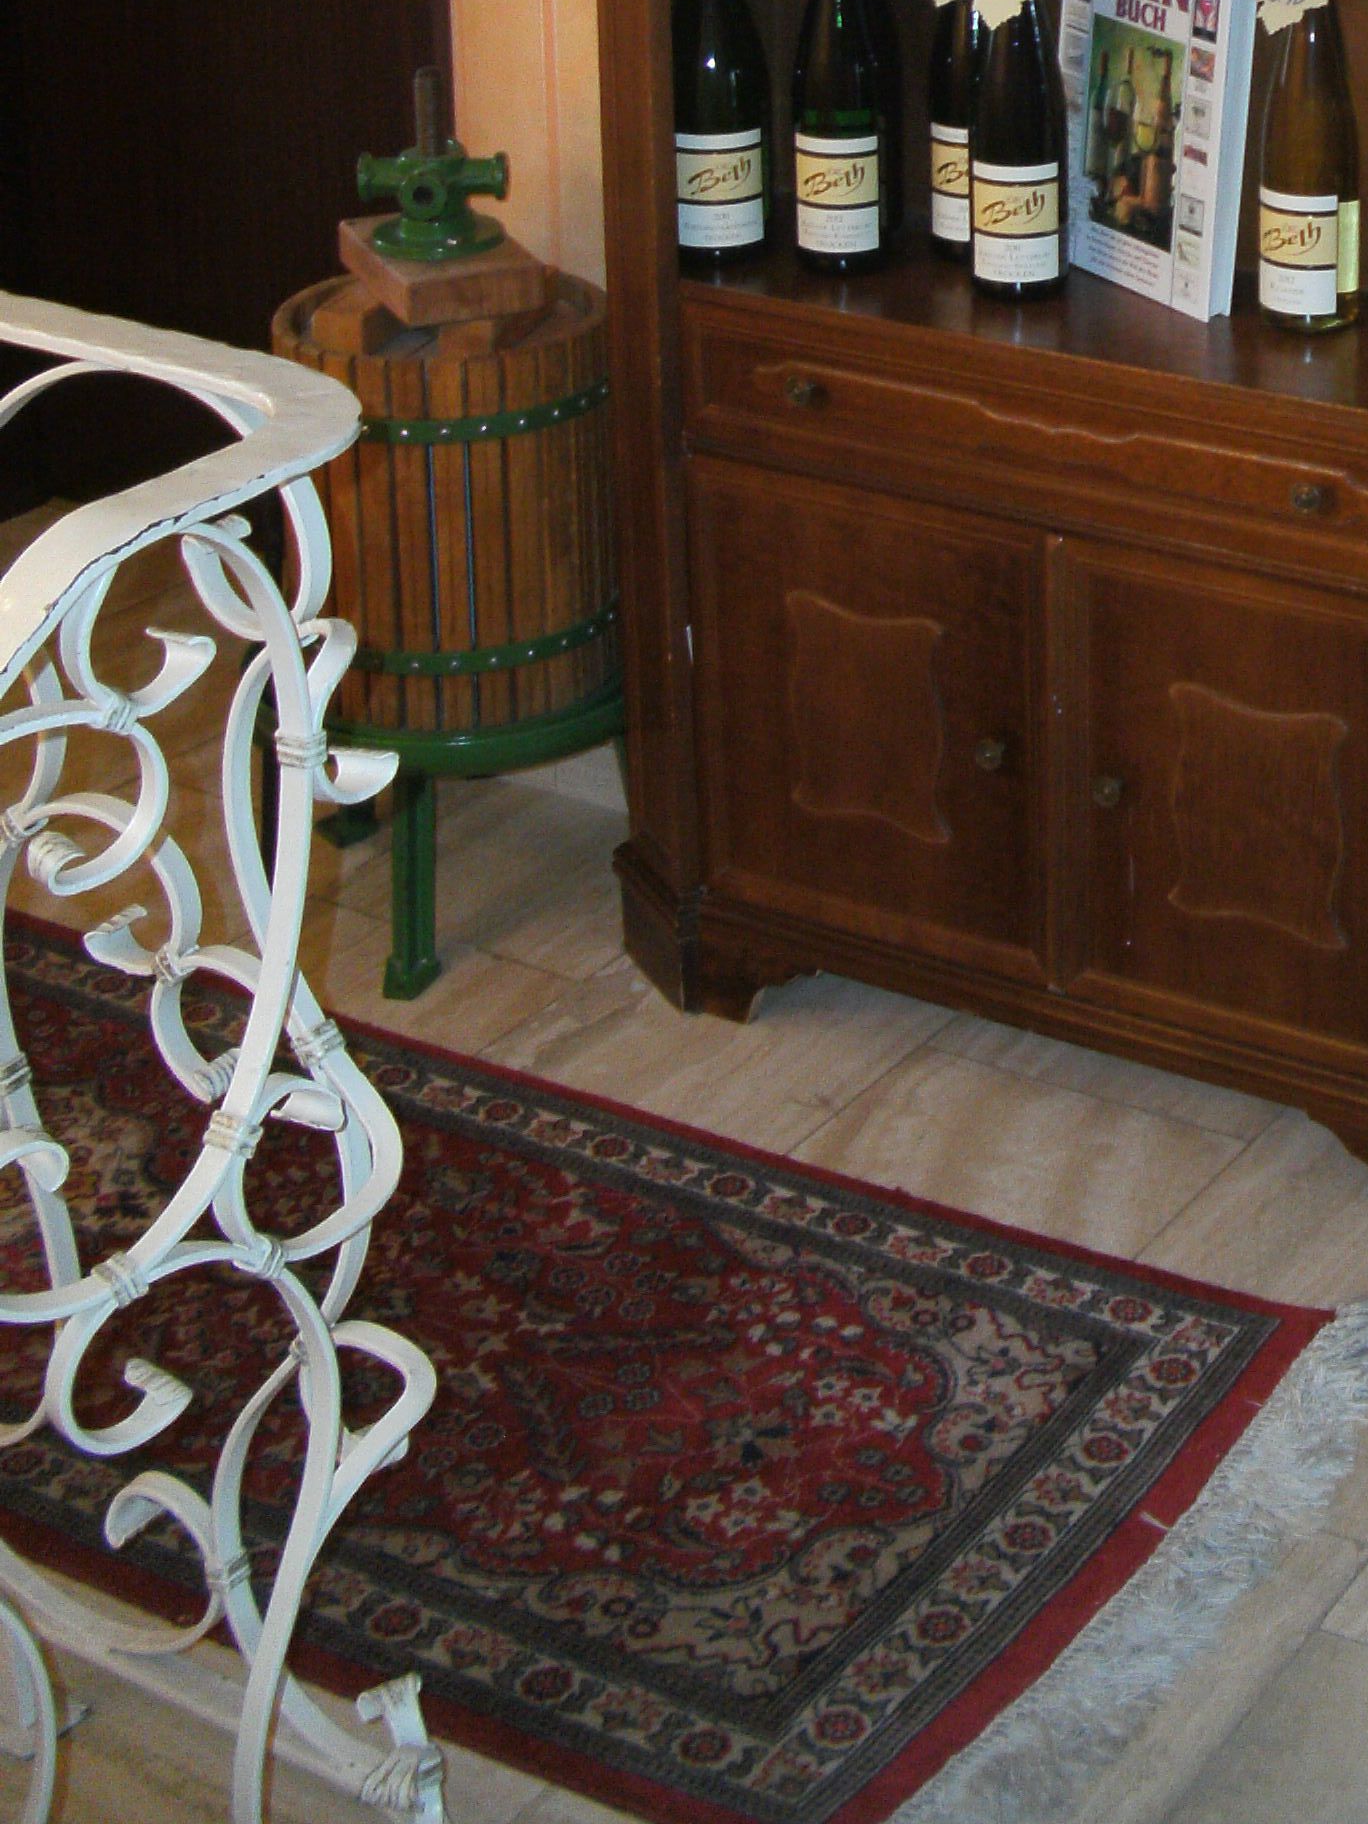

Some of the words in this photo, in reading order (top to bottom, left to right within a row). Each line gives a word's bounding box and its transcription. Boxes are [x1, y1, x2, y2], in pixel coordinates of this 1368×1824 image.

[688, 156, 751, 196] Beth
[804, 162, 865, 197] Beth
[981, 190, 1045, 226] Beth
